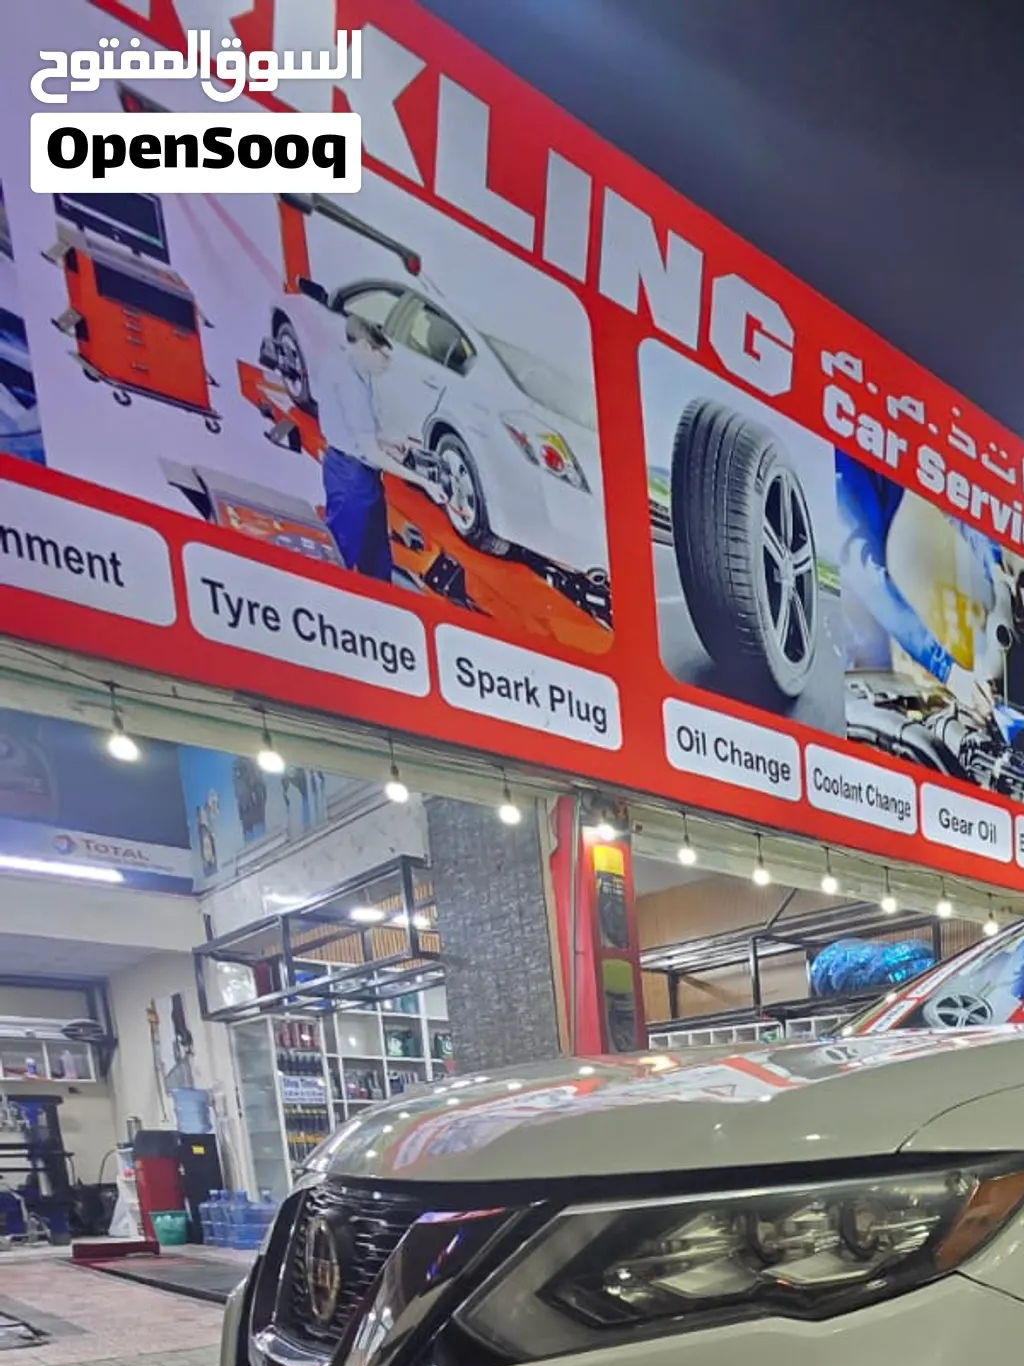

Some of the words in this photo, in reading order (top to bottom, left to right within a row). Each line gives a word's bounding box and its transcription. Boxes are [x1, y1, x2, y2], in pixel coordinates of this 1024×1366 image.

[823, 384, 908, 469] Car
[201, 577, 281, 632] Tyre
[293, 608, 416, 674] Change
[455, 657, 540, 707] Spark
[549, 685, 608, 734] Plug
[677, 725, 707, 757] Oil
[714, 737, 791, 783] Change
[813, 767, 863, 804] Coolant
[866, 784, 911, 821] Change
[80, 838, 150, 861] TOTAL
[939, 808, 973, 836] Gear
[978, 821, 997, 844] Oil
